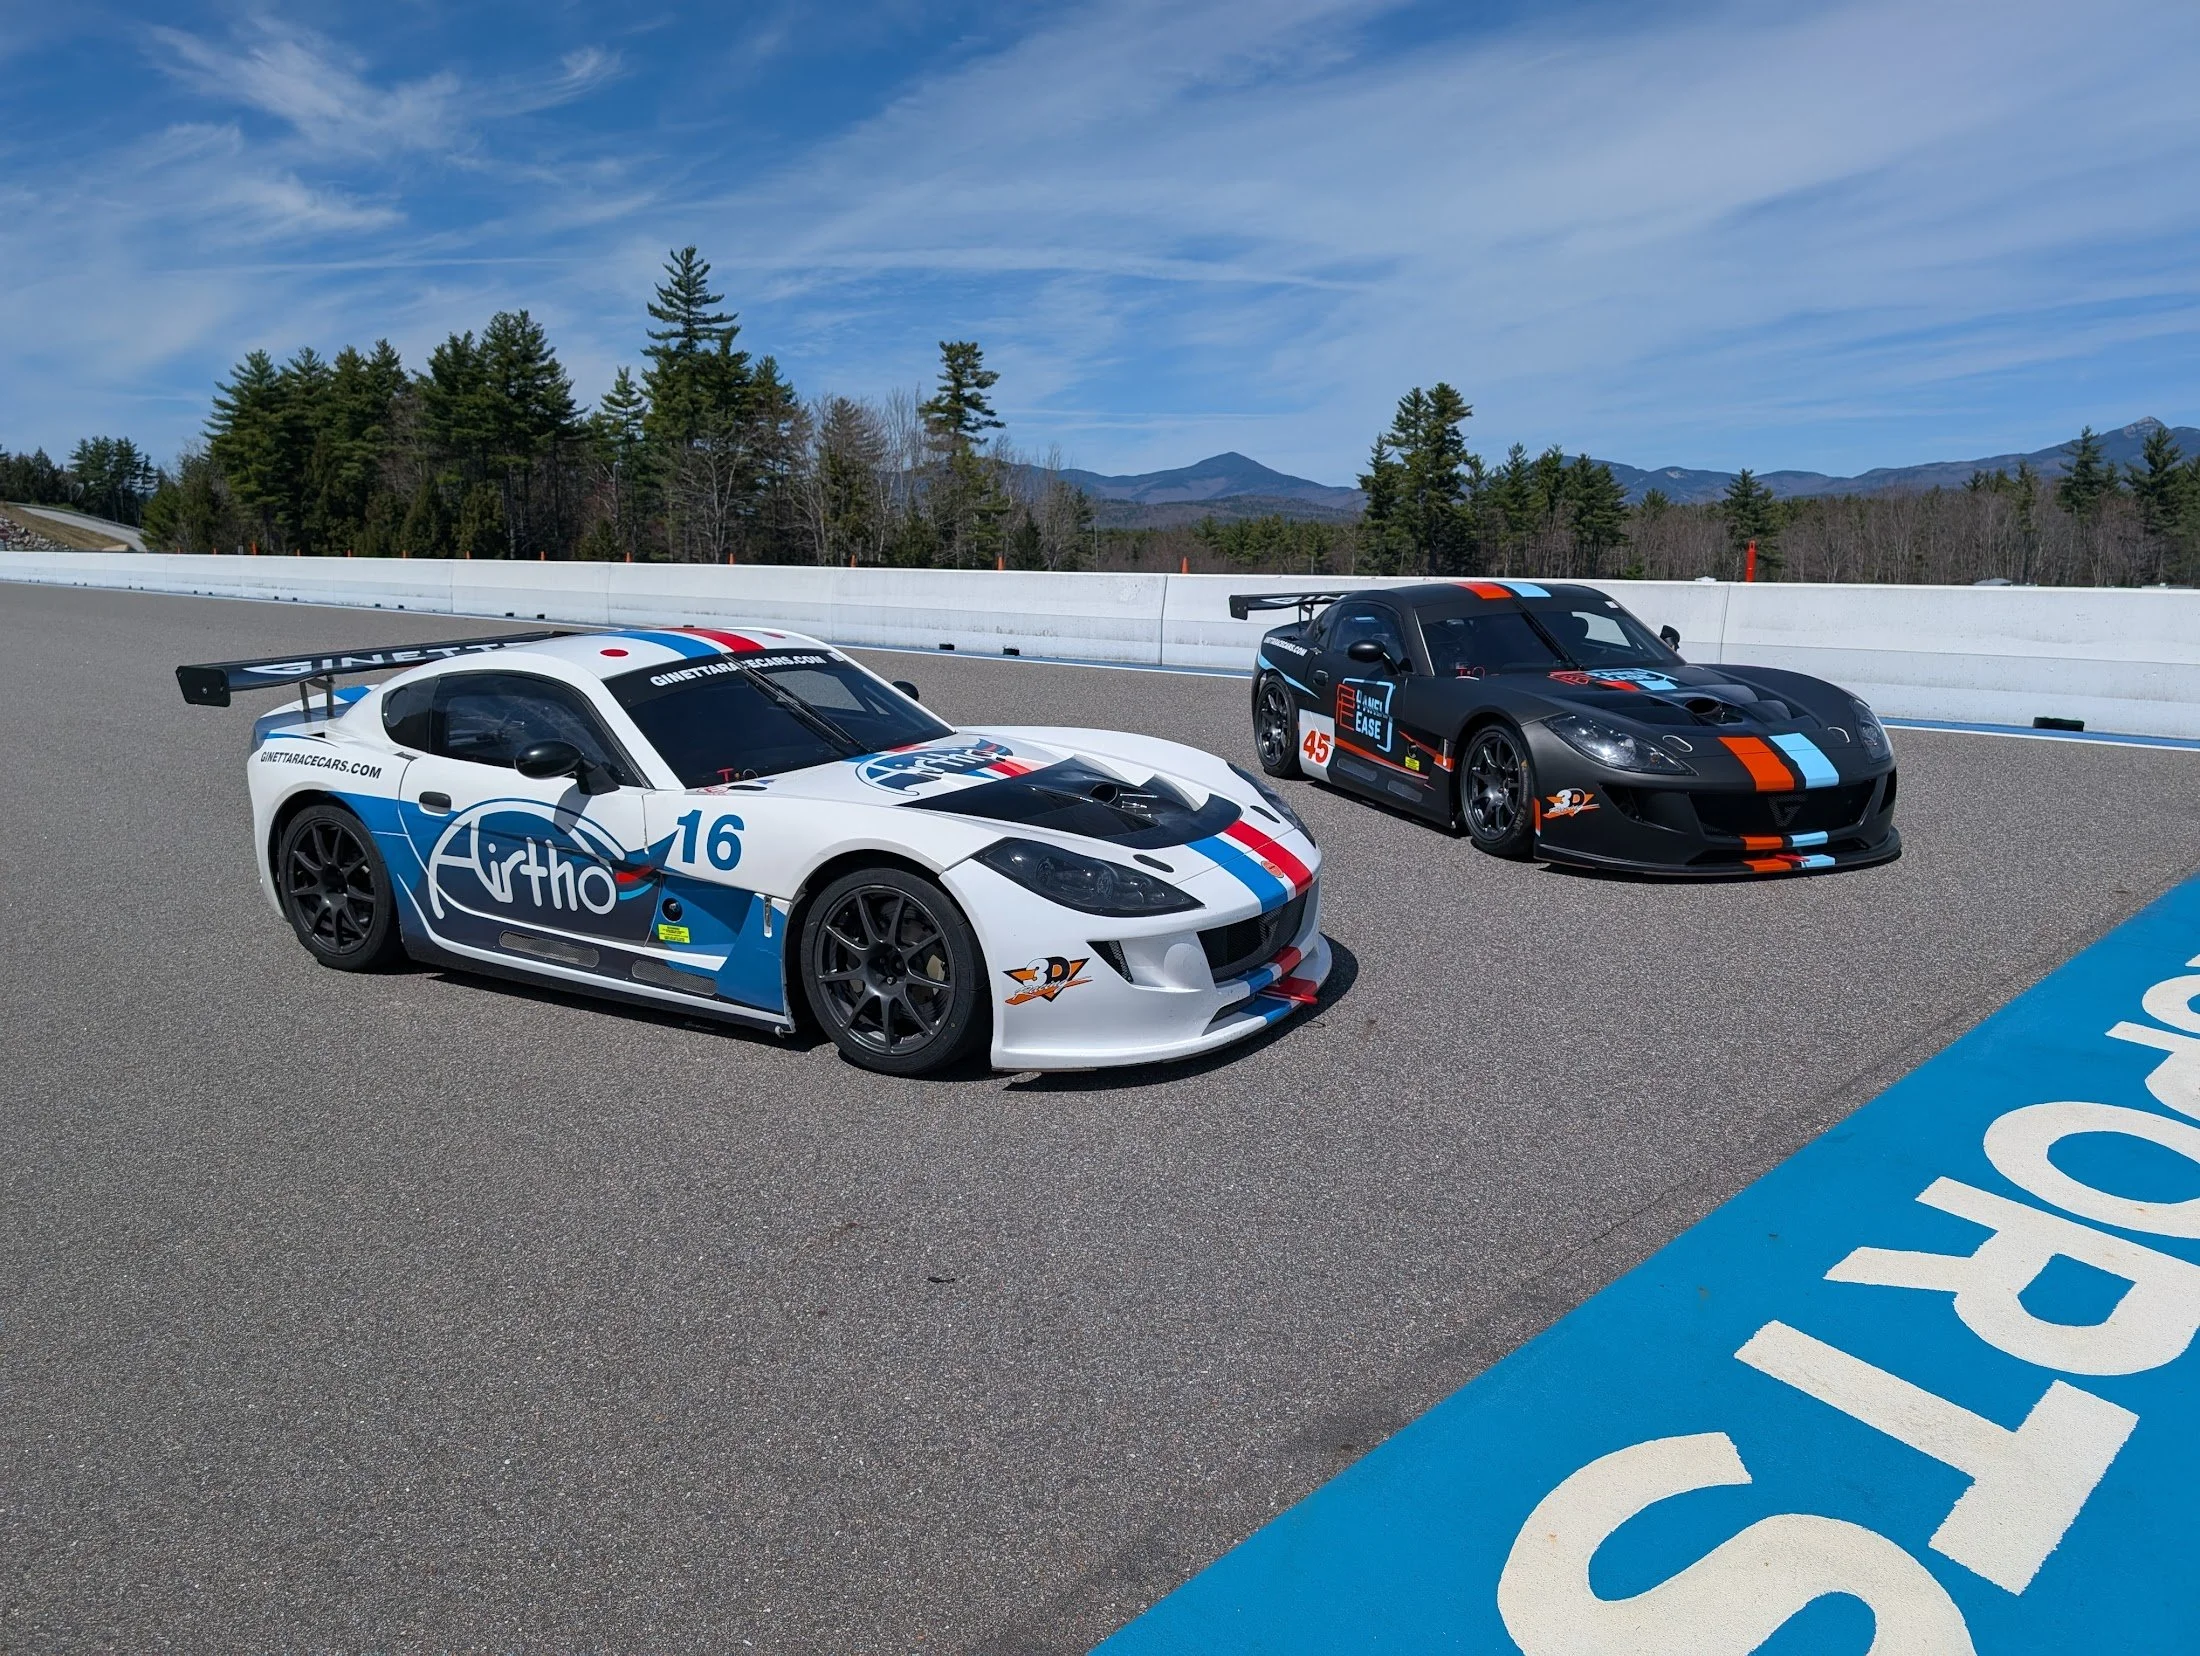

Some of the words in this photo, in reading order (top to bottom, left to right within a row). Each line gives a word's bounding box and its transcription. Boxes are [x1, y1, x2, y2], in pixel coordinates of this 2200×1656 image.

[1355, 711, 1382, 740] EASE
[1303, 730, 1331, 764] 45
[261, 751, 382, 779] GINETTARACECARS.COM
[1554, 788, 1586, 808] 3D
[676, 809, 745, 872] 16
[427, 800, 626, 920] Airtho
[1023, 956, 1071, 988] 3D
